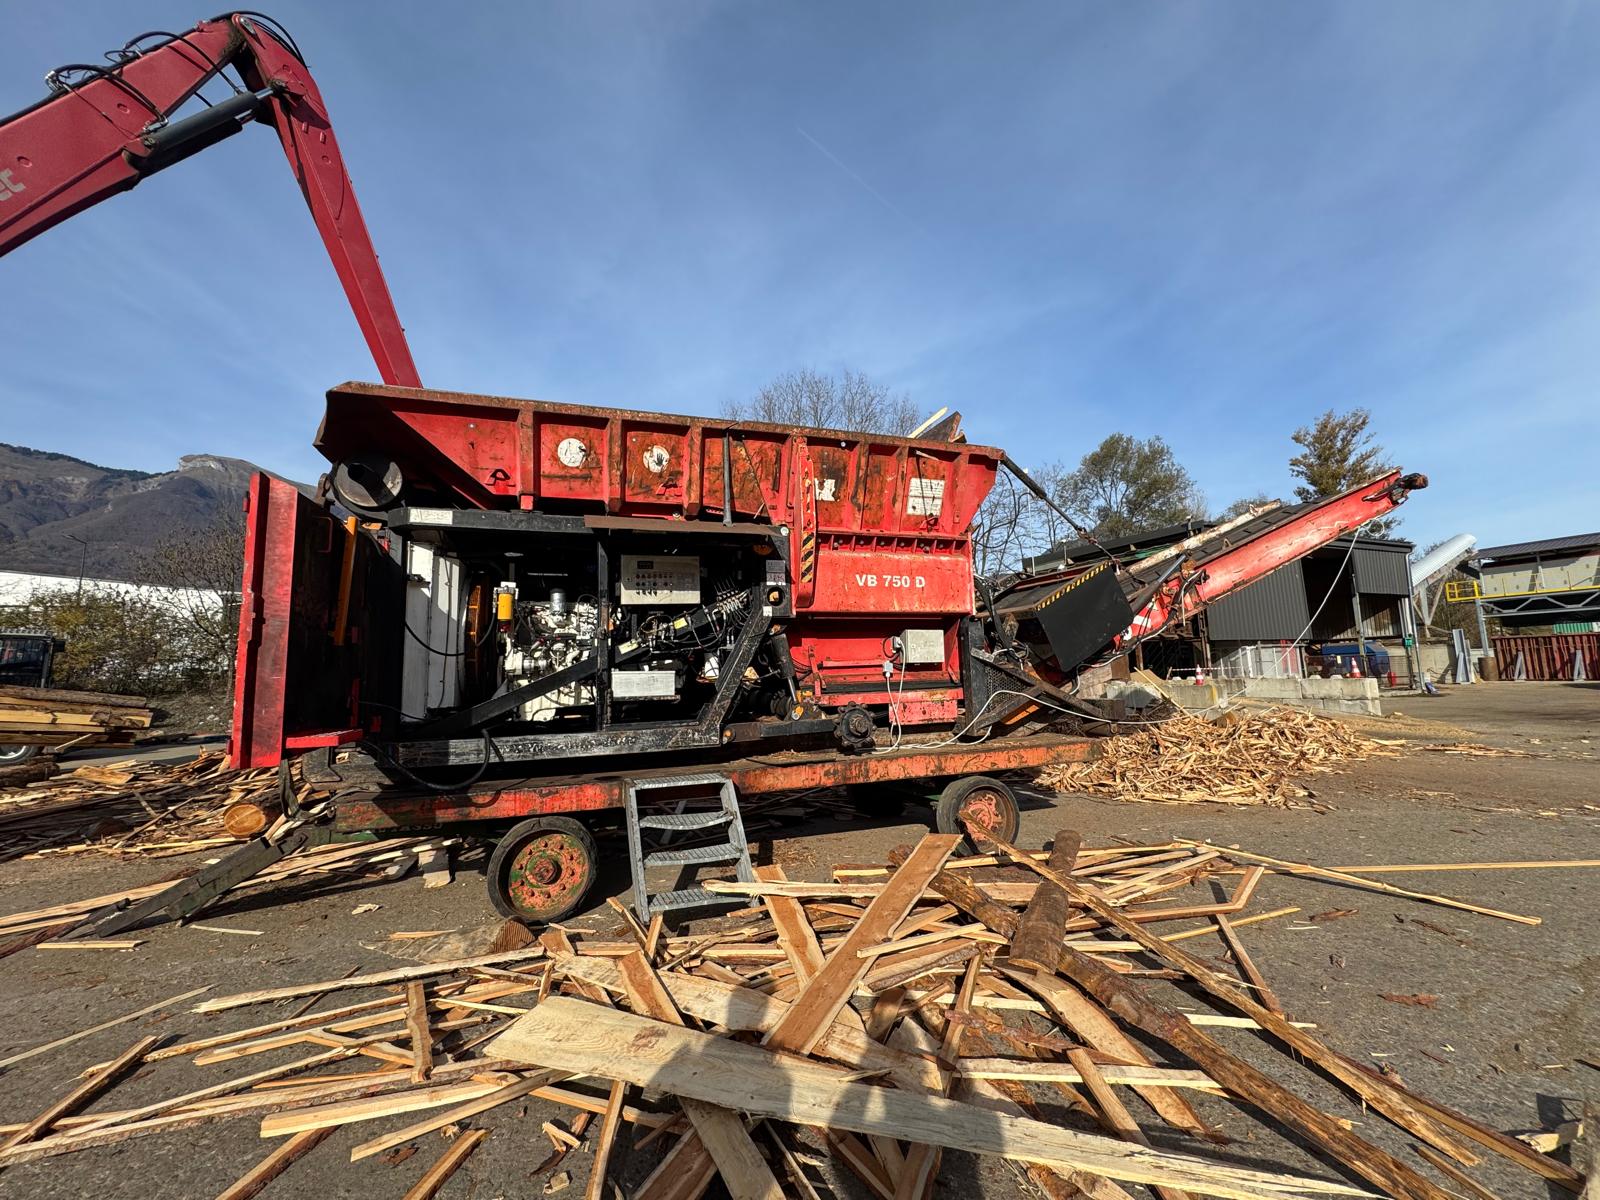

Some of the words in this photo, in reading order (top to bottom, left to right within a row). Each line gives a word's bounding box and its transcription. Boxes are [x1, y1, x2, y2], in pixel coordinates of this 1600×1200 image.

[855, 574, 878, 587] VB
[882, 575, 911, 588] 750
[915, 576, 926, 588] D
